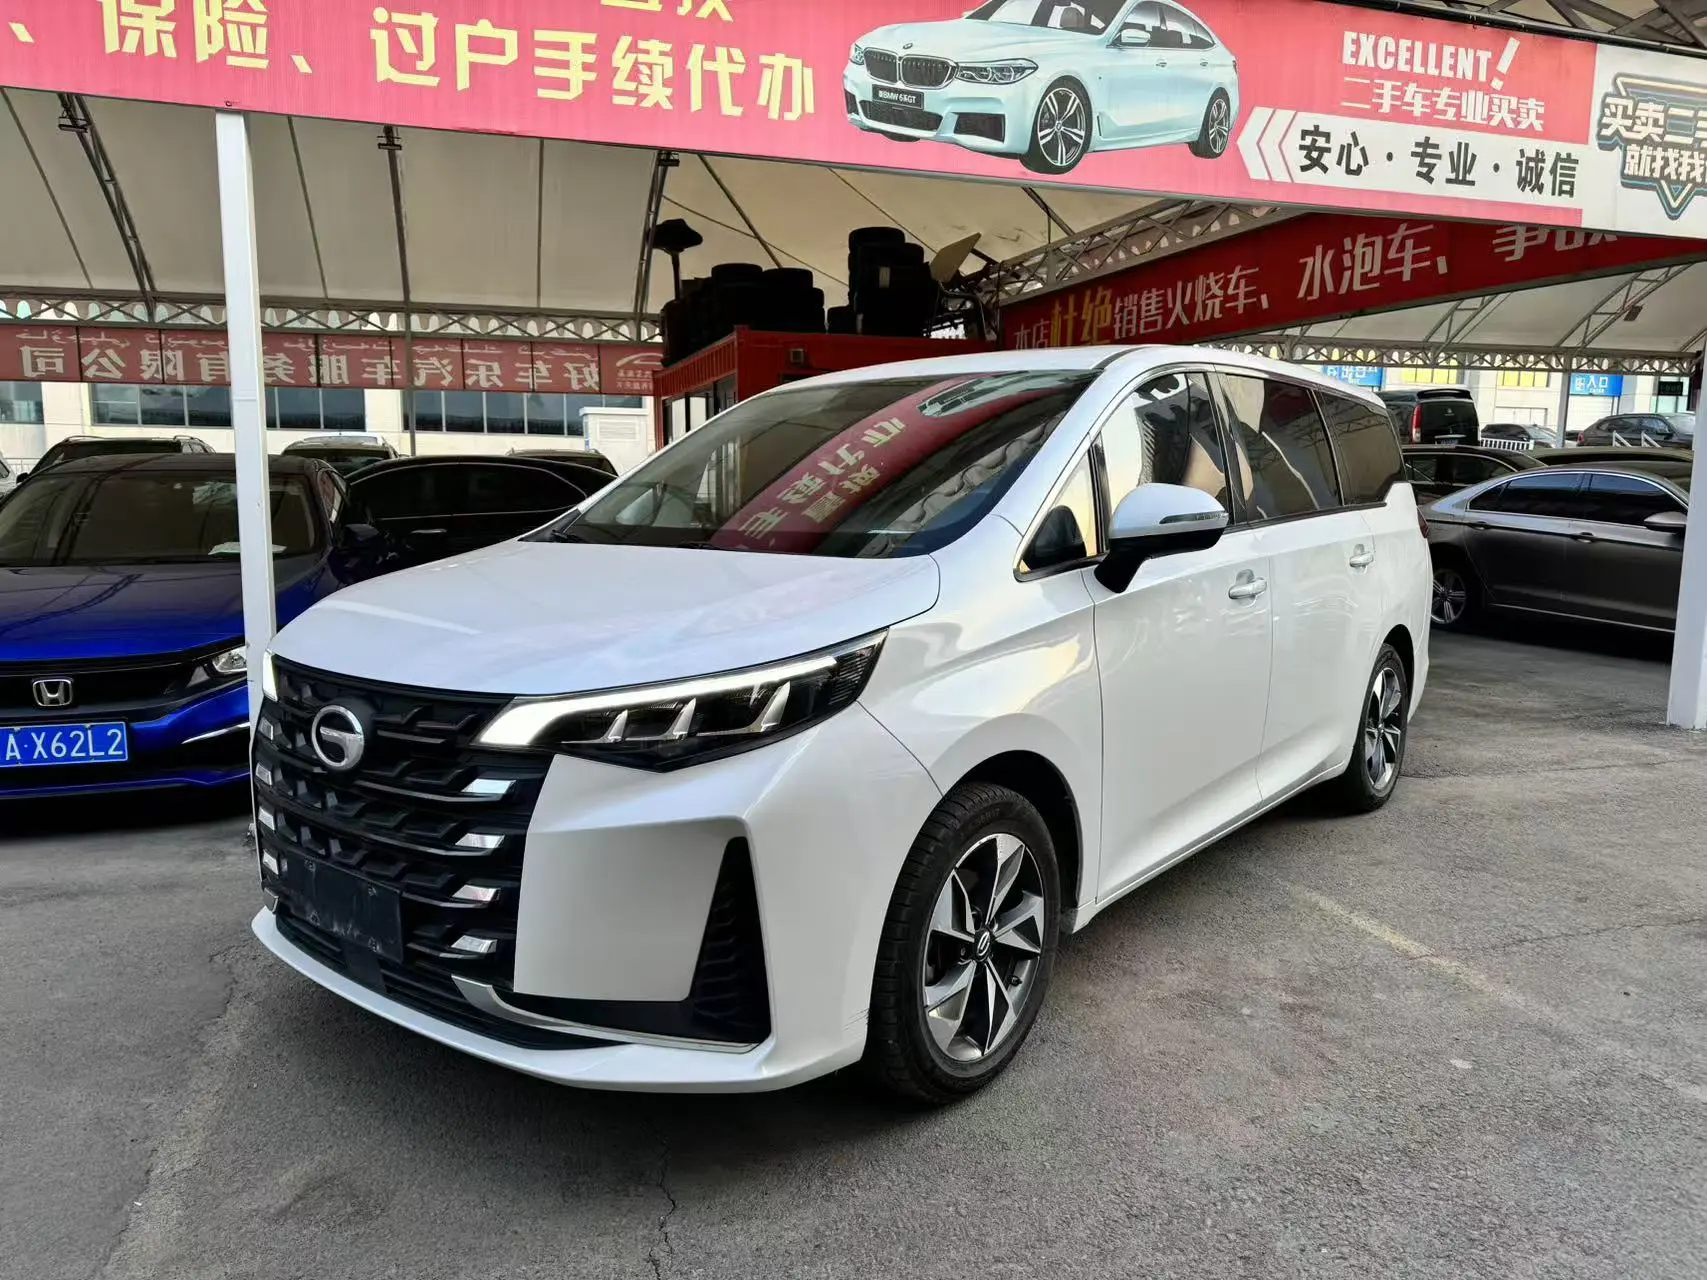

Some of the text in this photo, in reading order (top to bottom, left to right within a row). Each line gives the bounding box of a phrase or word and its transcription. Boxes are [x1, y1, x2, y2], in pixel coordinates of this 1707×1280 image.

[1341, 76, 1546, 131] 二手车专业买卖
[1624, 144, 1707, 182] 就找我
[6, 728, 124, 761] A·X62L2
